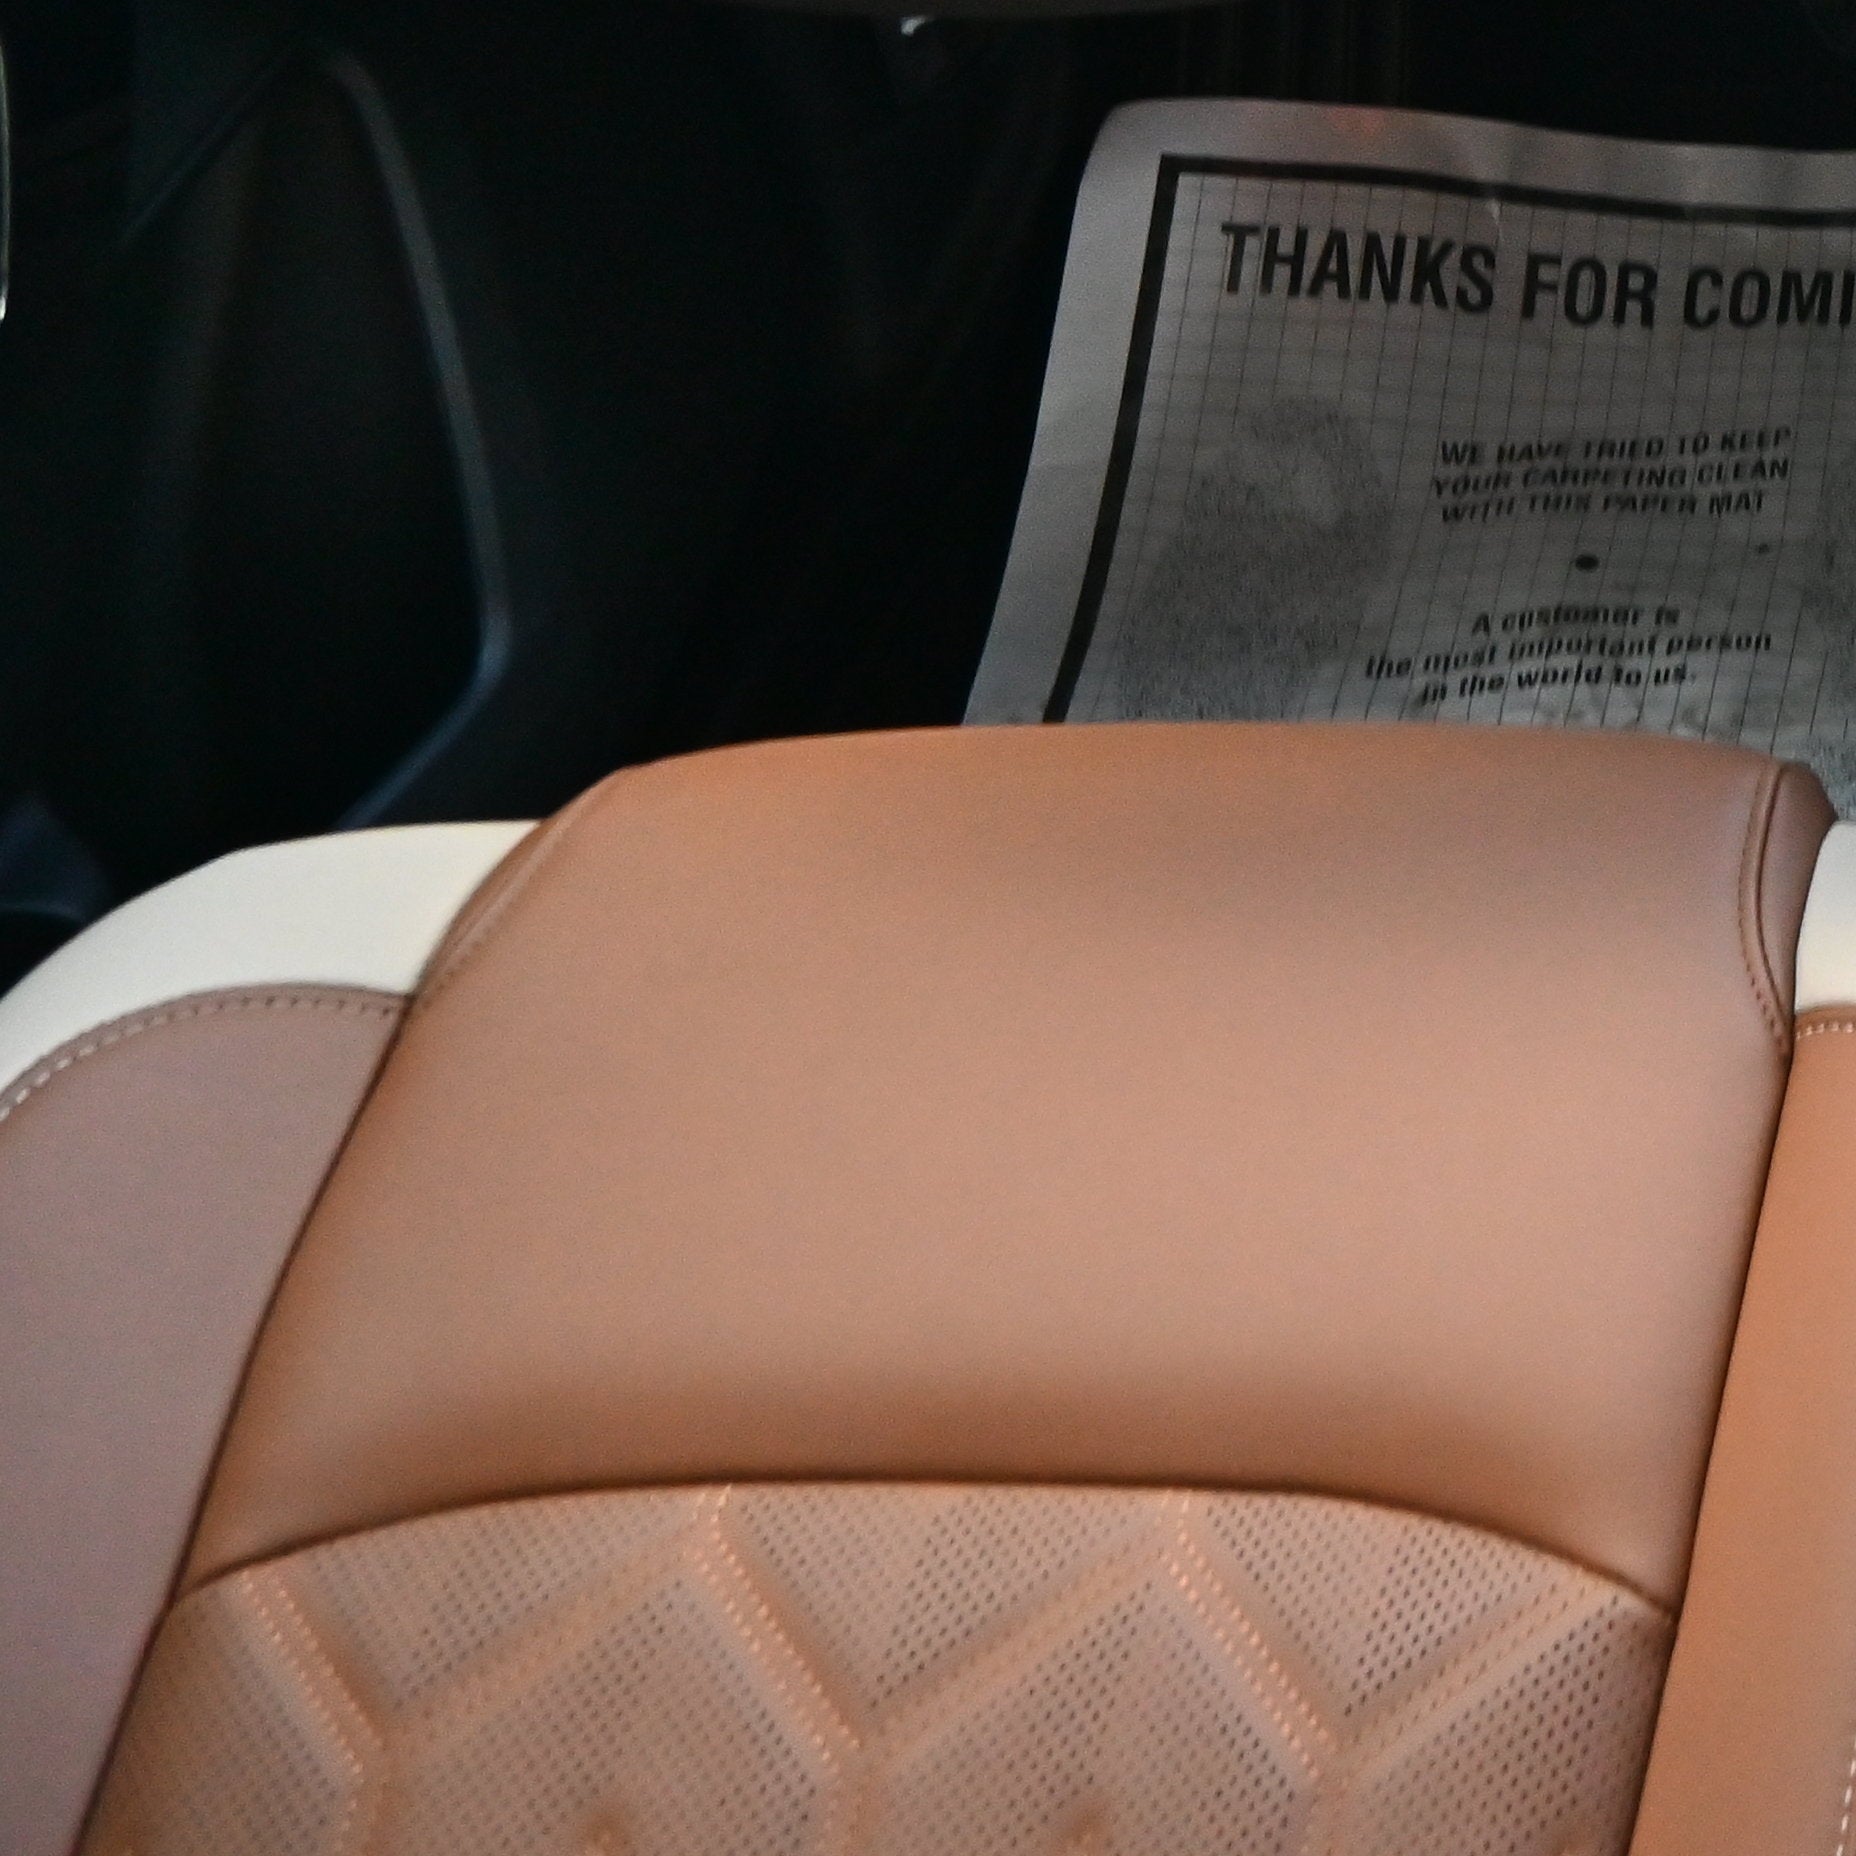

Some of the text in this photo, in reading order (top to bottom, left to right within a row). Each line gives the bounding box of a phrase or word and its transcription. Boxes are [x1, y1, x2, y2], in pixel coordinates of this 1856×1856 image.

[1220, 222, 1498, 314] THANKS
[1520, 251, 1659, 328] FOR
[1441, 425, 1792, 466] WE HAVE TRIED TO KEEP
[1434, 456, 1791, 498] YOUR CARPETING CLEAN
[1441, 488, 1765, 523] WITH THIS PAPER MAT
[1471, 604, 1681, 636] A customer is
[1365, 632, 1771, 679] the most important person
[1459, 673, 1505, 698] the
[1516, 661, 1602, 691] world
[1613, 663, 1642, 687] to
